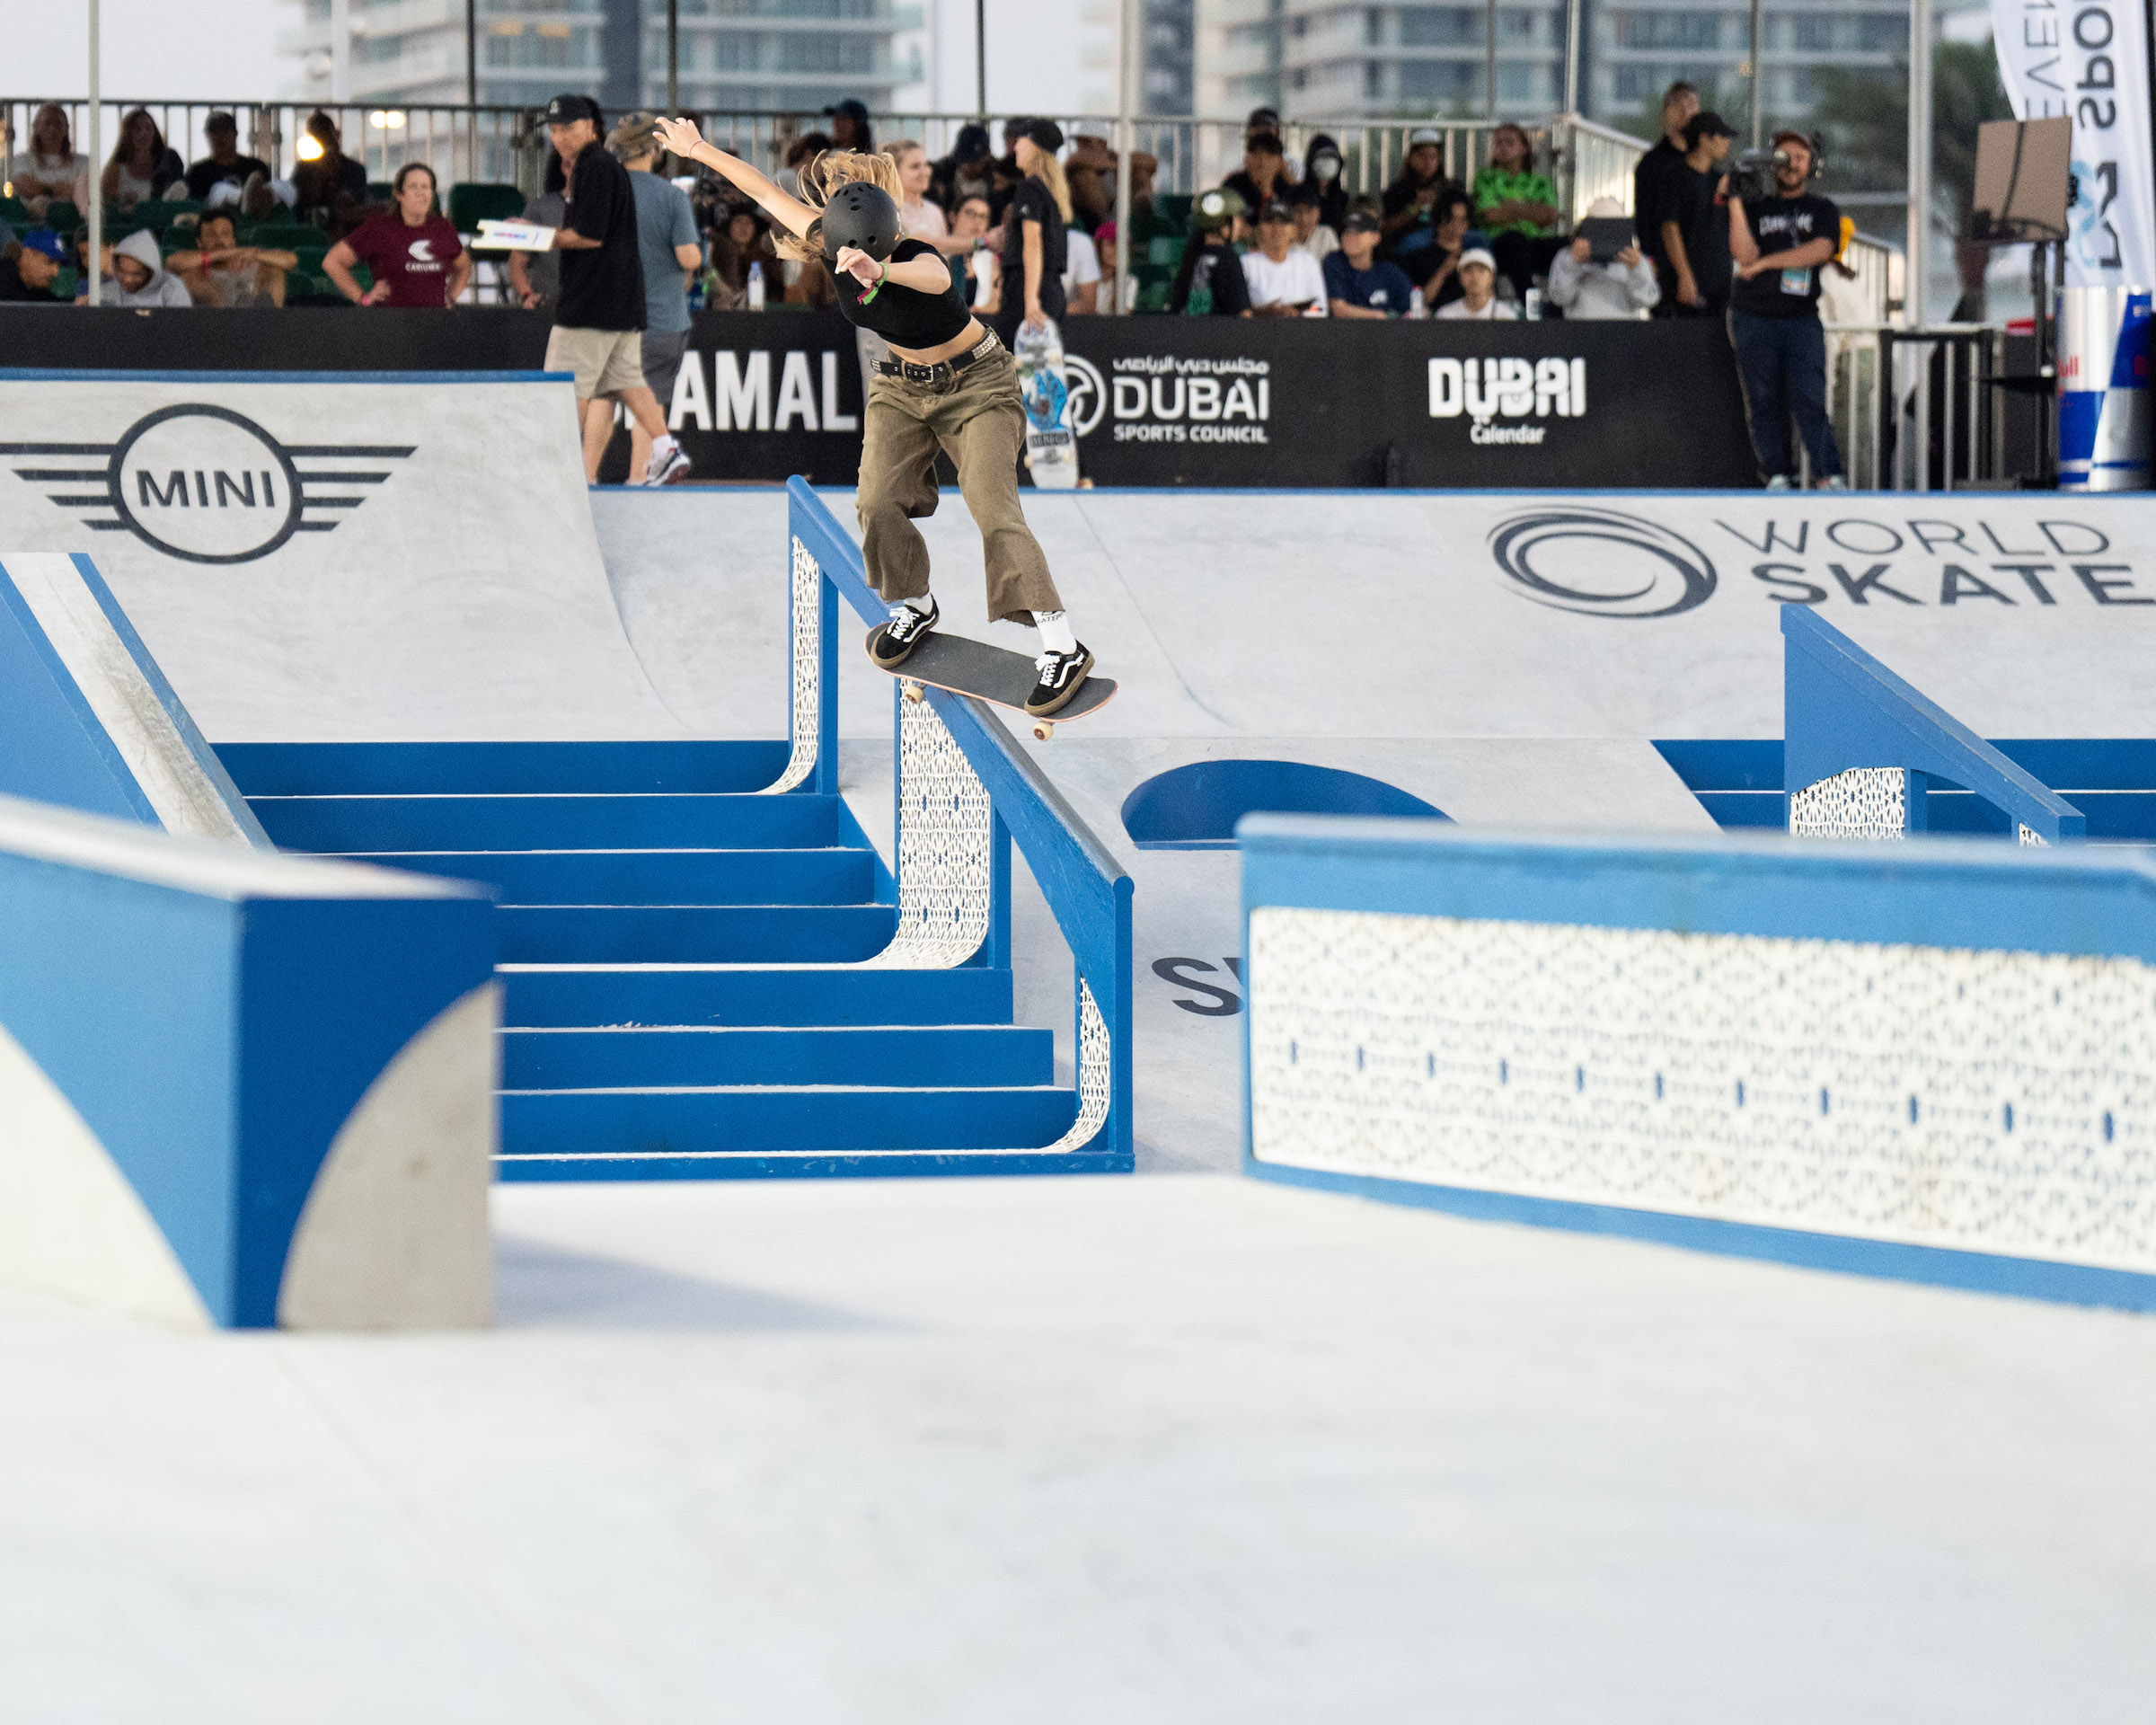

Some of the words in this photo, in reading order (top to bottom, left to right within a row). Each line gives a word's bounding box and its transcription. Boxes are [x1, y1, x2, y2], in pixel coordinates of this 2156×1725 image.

[1175, 358, 1211, 375] دبي
[1213, 357, 1270, 376] مجلس
[1112, 376, 1269, 420] DUBAI
[1427, 357, 1587, 419] DUBAI
[1114, 424, 1187, 442] SPORTS
[1189, 425, 1268, 444] COUNCIL
[1470, 424, 1546, 445] Calendar
[136, 470, 276, 508] MINI
[1713, 518, 2110, 556] WORLD
[1750, 562, 2156, 606] SKATE
